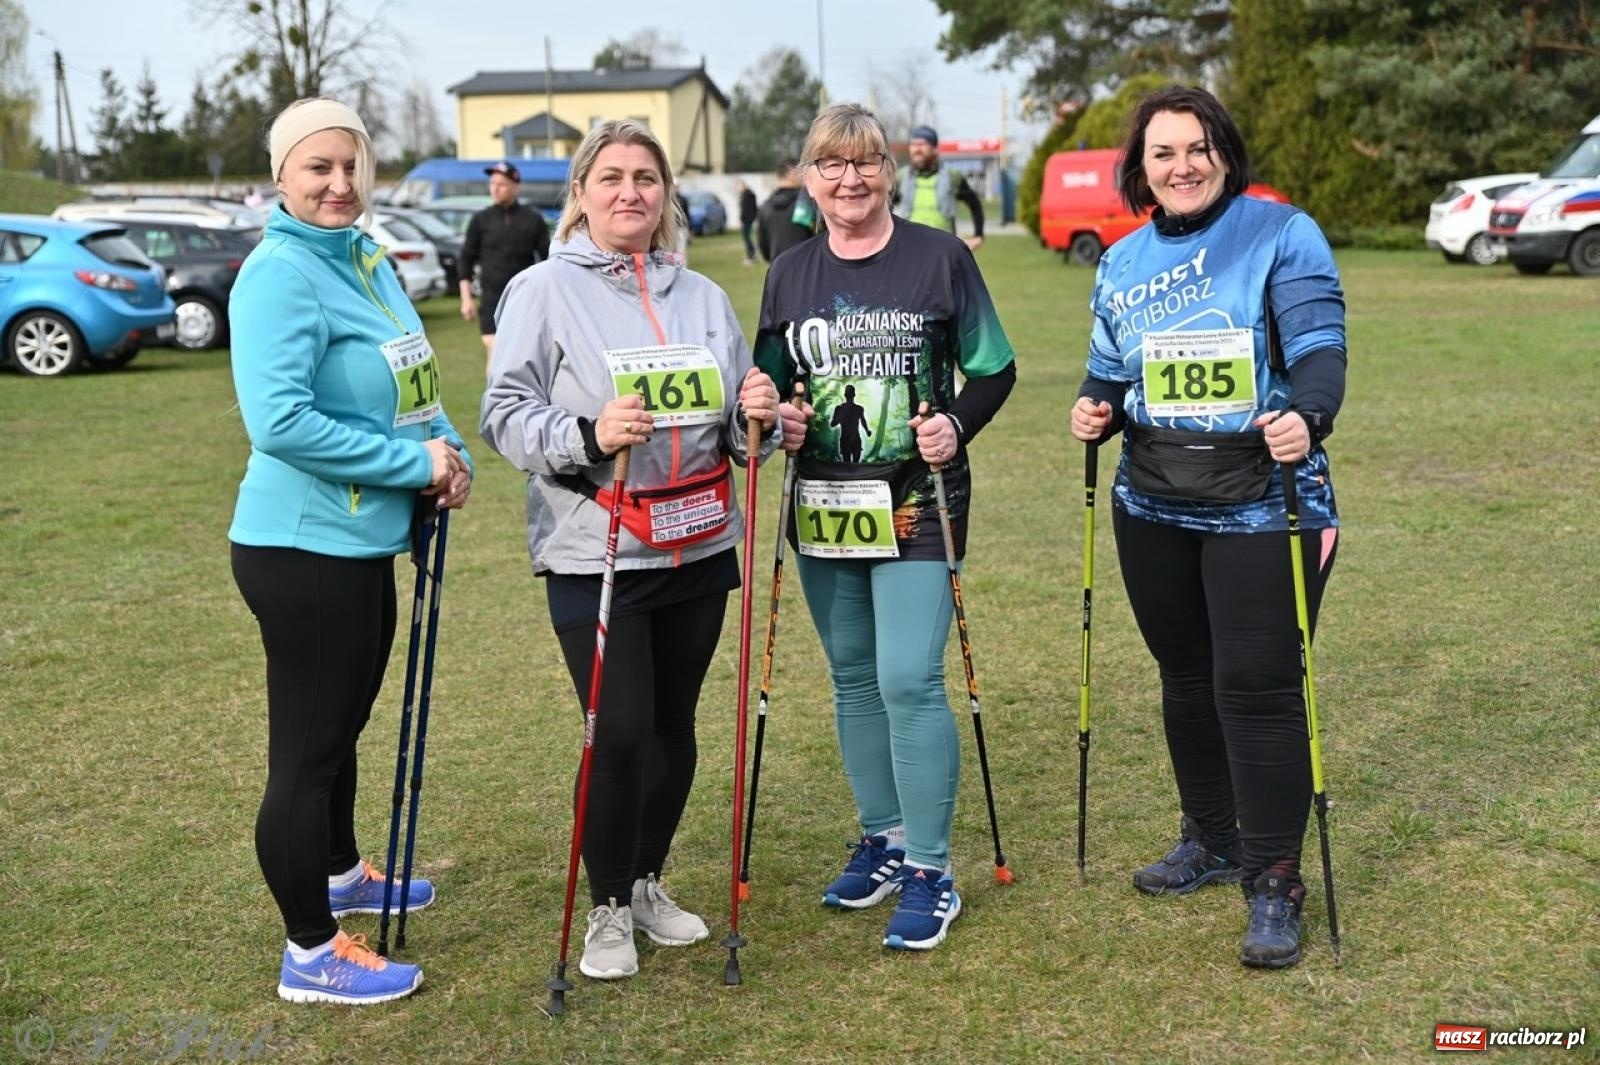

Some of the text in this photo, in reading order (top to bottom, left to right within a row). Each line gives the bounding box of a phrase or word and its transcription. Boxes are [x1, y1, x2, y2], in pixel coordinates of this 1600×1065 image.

[1107, 248, 1207, 318] MORSY
[836, 309, 924, 332] KUŹNIAŃSKI
[836, 335, 924, 349] PÓŁMARATON LEŚNY
[838, 353, 921, 376] RAFAMET
[632, 371, 709, 411] 161
[1160, 361, 1236, 400] 185
[652, 494, 714, 515] To the doers.
[653, 504, 722, 529] To the unique.
[654, 531, 666, 542] To
[668, 527, 683, 540] the
[808, 510, 878, 544] 170
